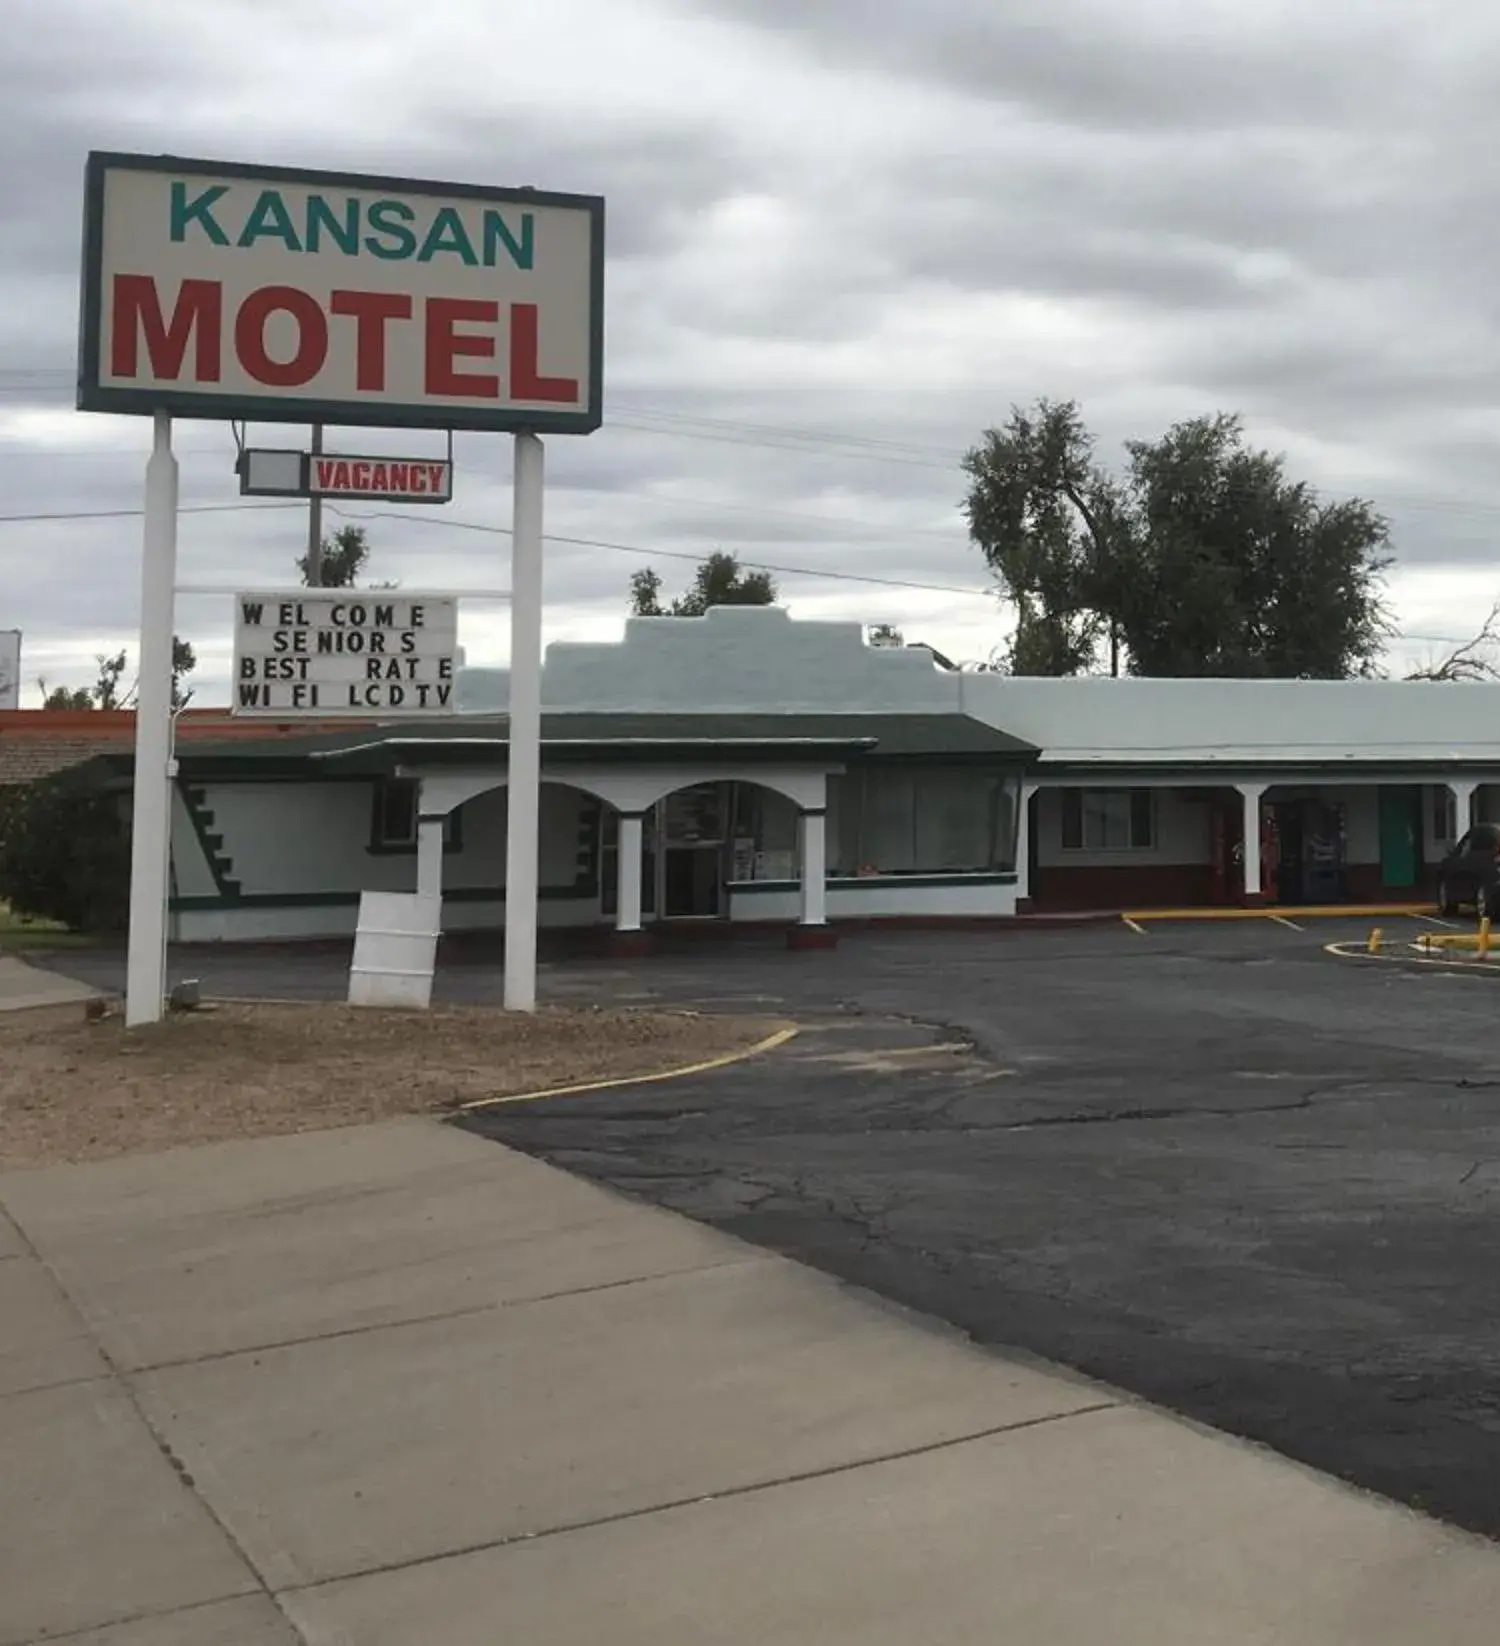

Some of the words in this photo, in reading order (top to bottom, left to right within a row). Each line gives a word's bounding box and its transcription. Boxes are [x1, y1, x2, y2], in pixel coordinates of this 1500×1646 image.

[170, 181, 534, 270] KANSAN
[111, 274, 579, 403] MOTEL
[316, 460, 445, 494] VACANCY
[273, 631, 416, 653] SENIORS
[241, 657, 311, 679] BEST
[367, 658, 453, 680] RATE
